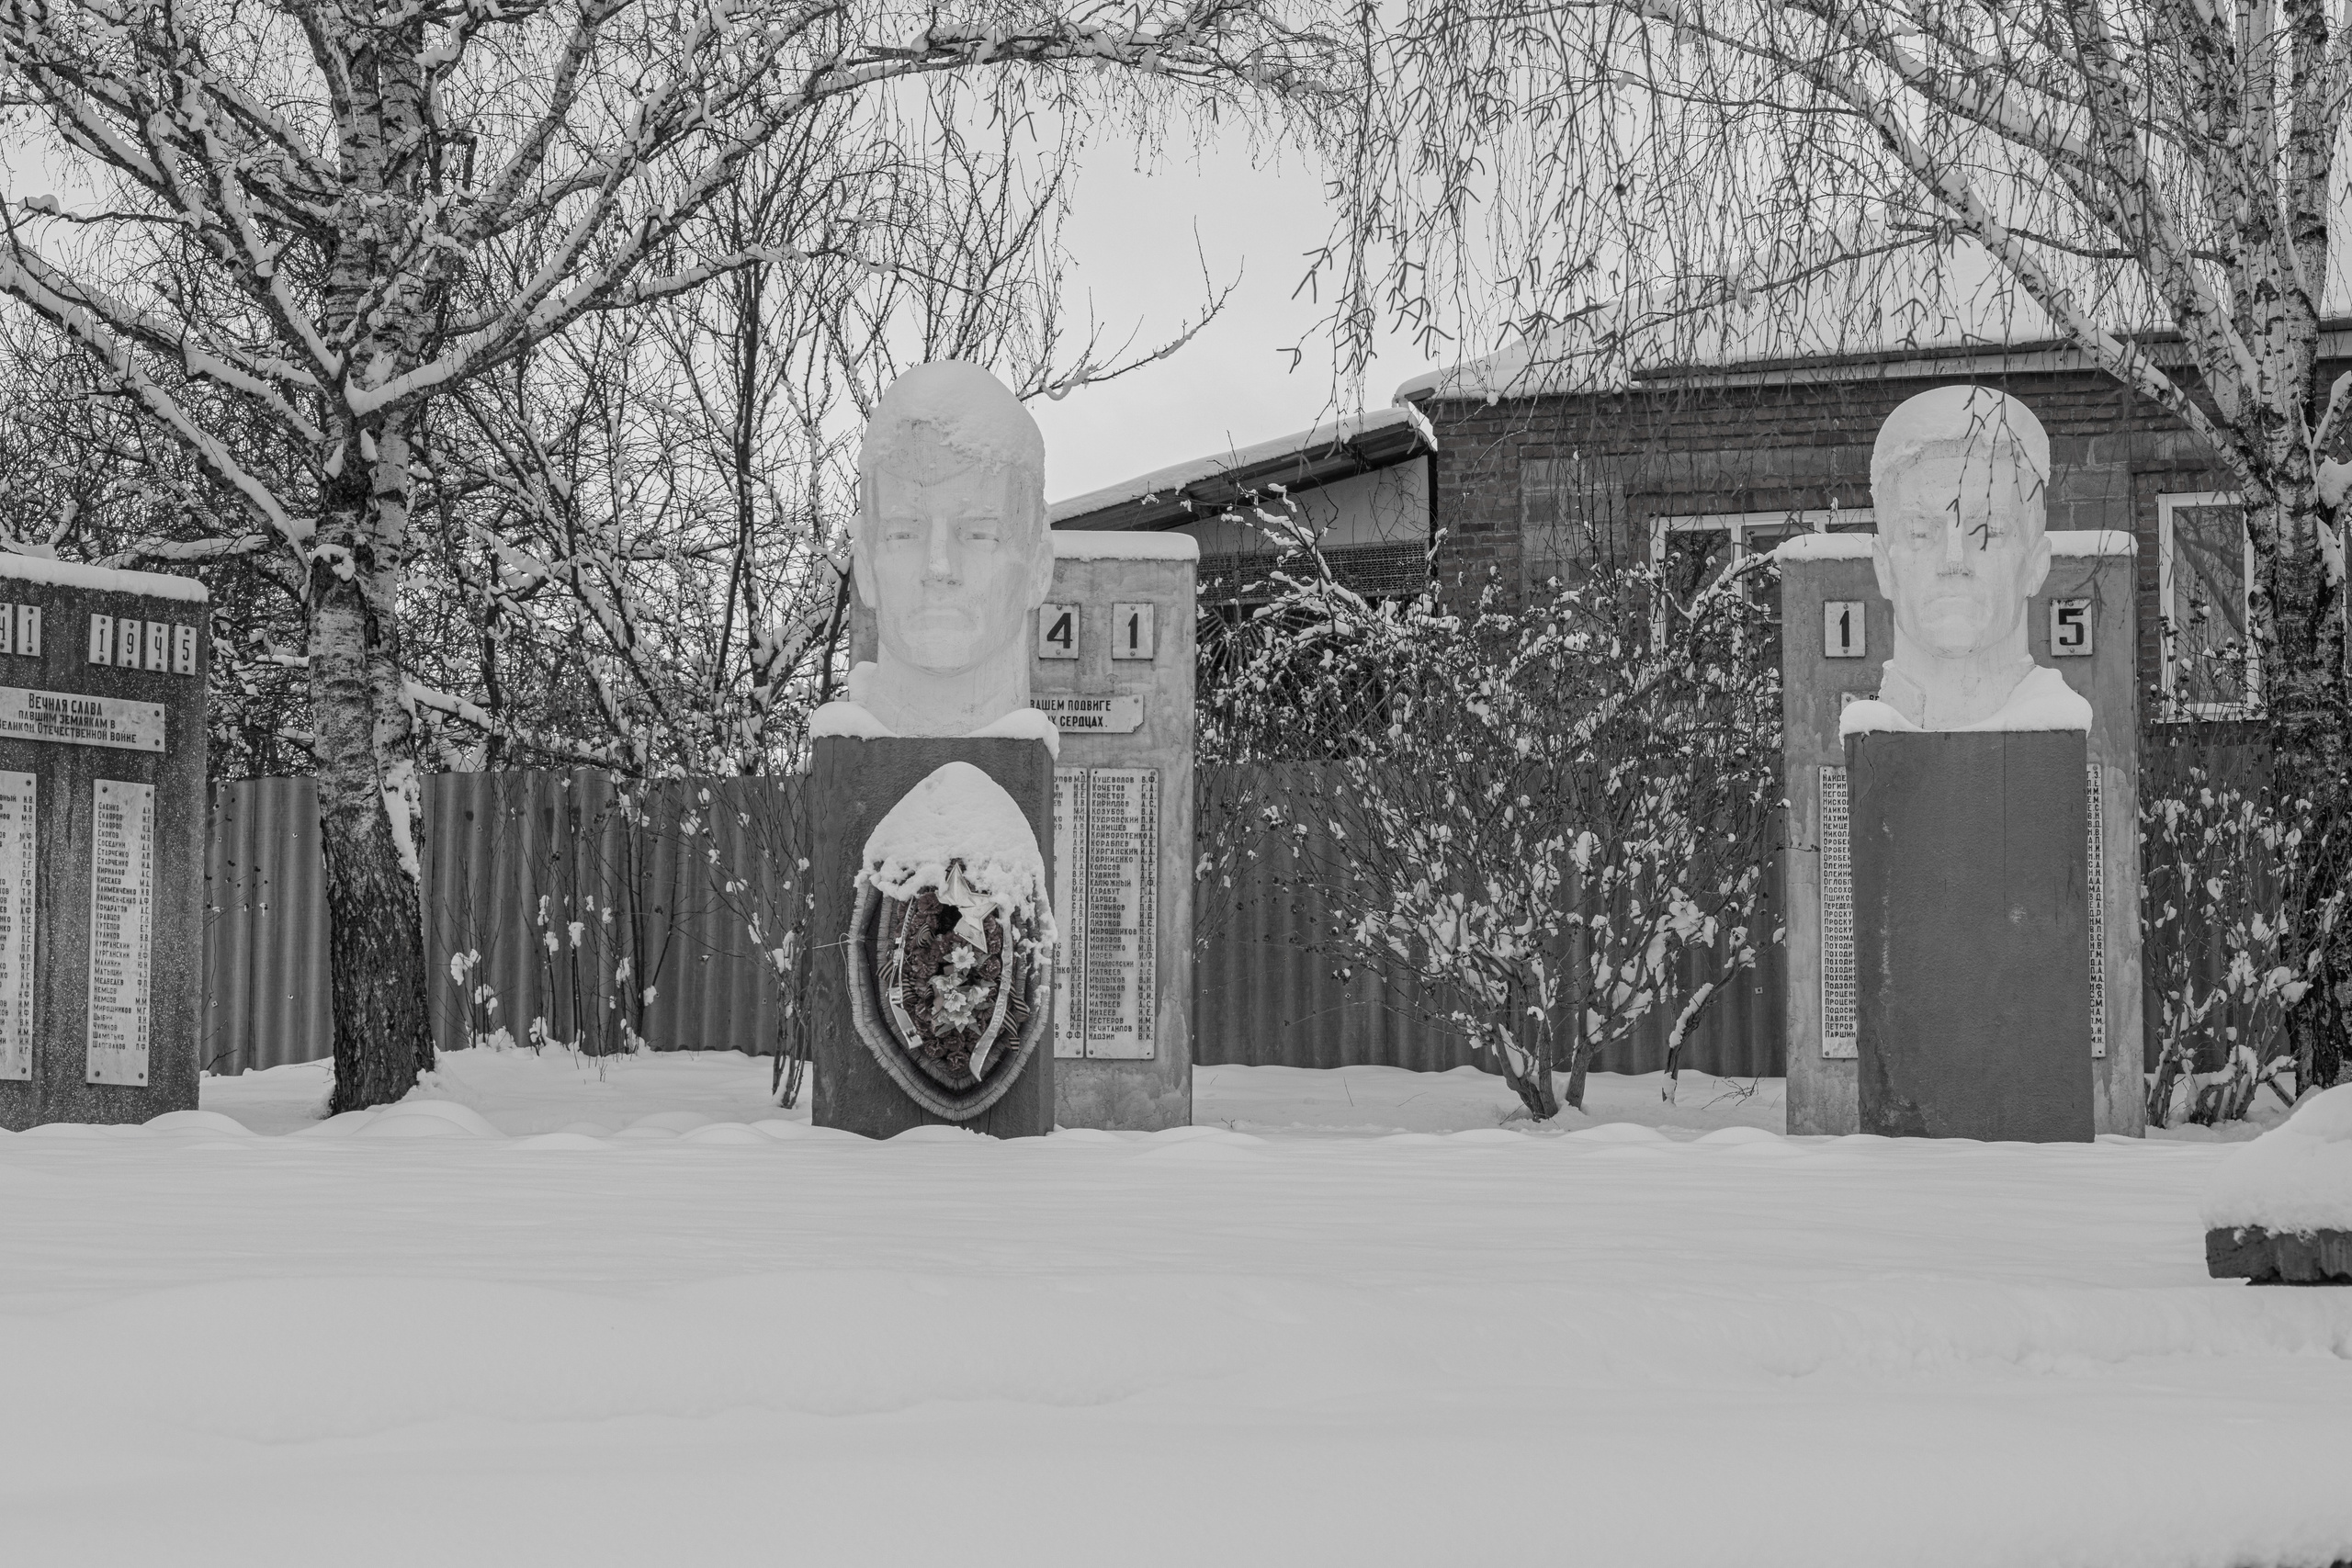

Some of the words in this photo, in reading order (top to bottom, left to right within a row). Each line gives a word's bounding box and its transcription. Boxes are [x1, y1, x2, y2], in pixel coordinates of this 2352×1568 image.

[1046, 612, 1073, 649] 4
[1127, 612, 1138, 649] 1
[1838, 610, 1849, 647] 1
[2058, 608, 2085, 646] 5
[71, 700, 103, 716] СЛАВА
[1030, 699, 1065, 711] ВАШЕМ
[1068, 700, 1112, 712] ПОДВИГЕ
[18, 710, 57, 724] ПАВШИМ
[59, 715, 107, 728] ЗЕМЛЯКАМ
[110, 720, 116, 729] В
[38, 722, 107, 740] ОТЕЧЕСТВЕННОЙ
[110, 731, 137, 743] ВОЙНЕ
[98, 829, 119, 839] СКОКОВ
[1090, 952, 1113, 960] МОРЕВ
[1090, 1000, 1120, 1009] МАТВЕЕВ
